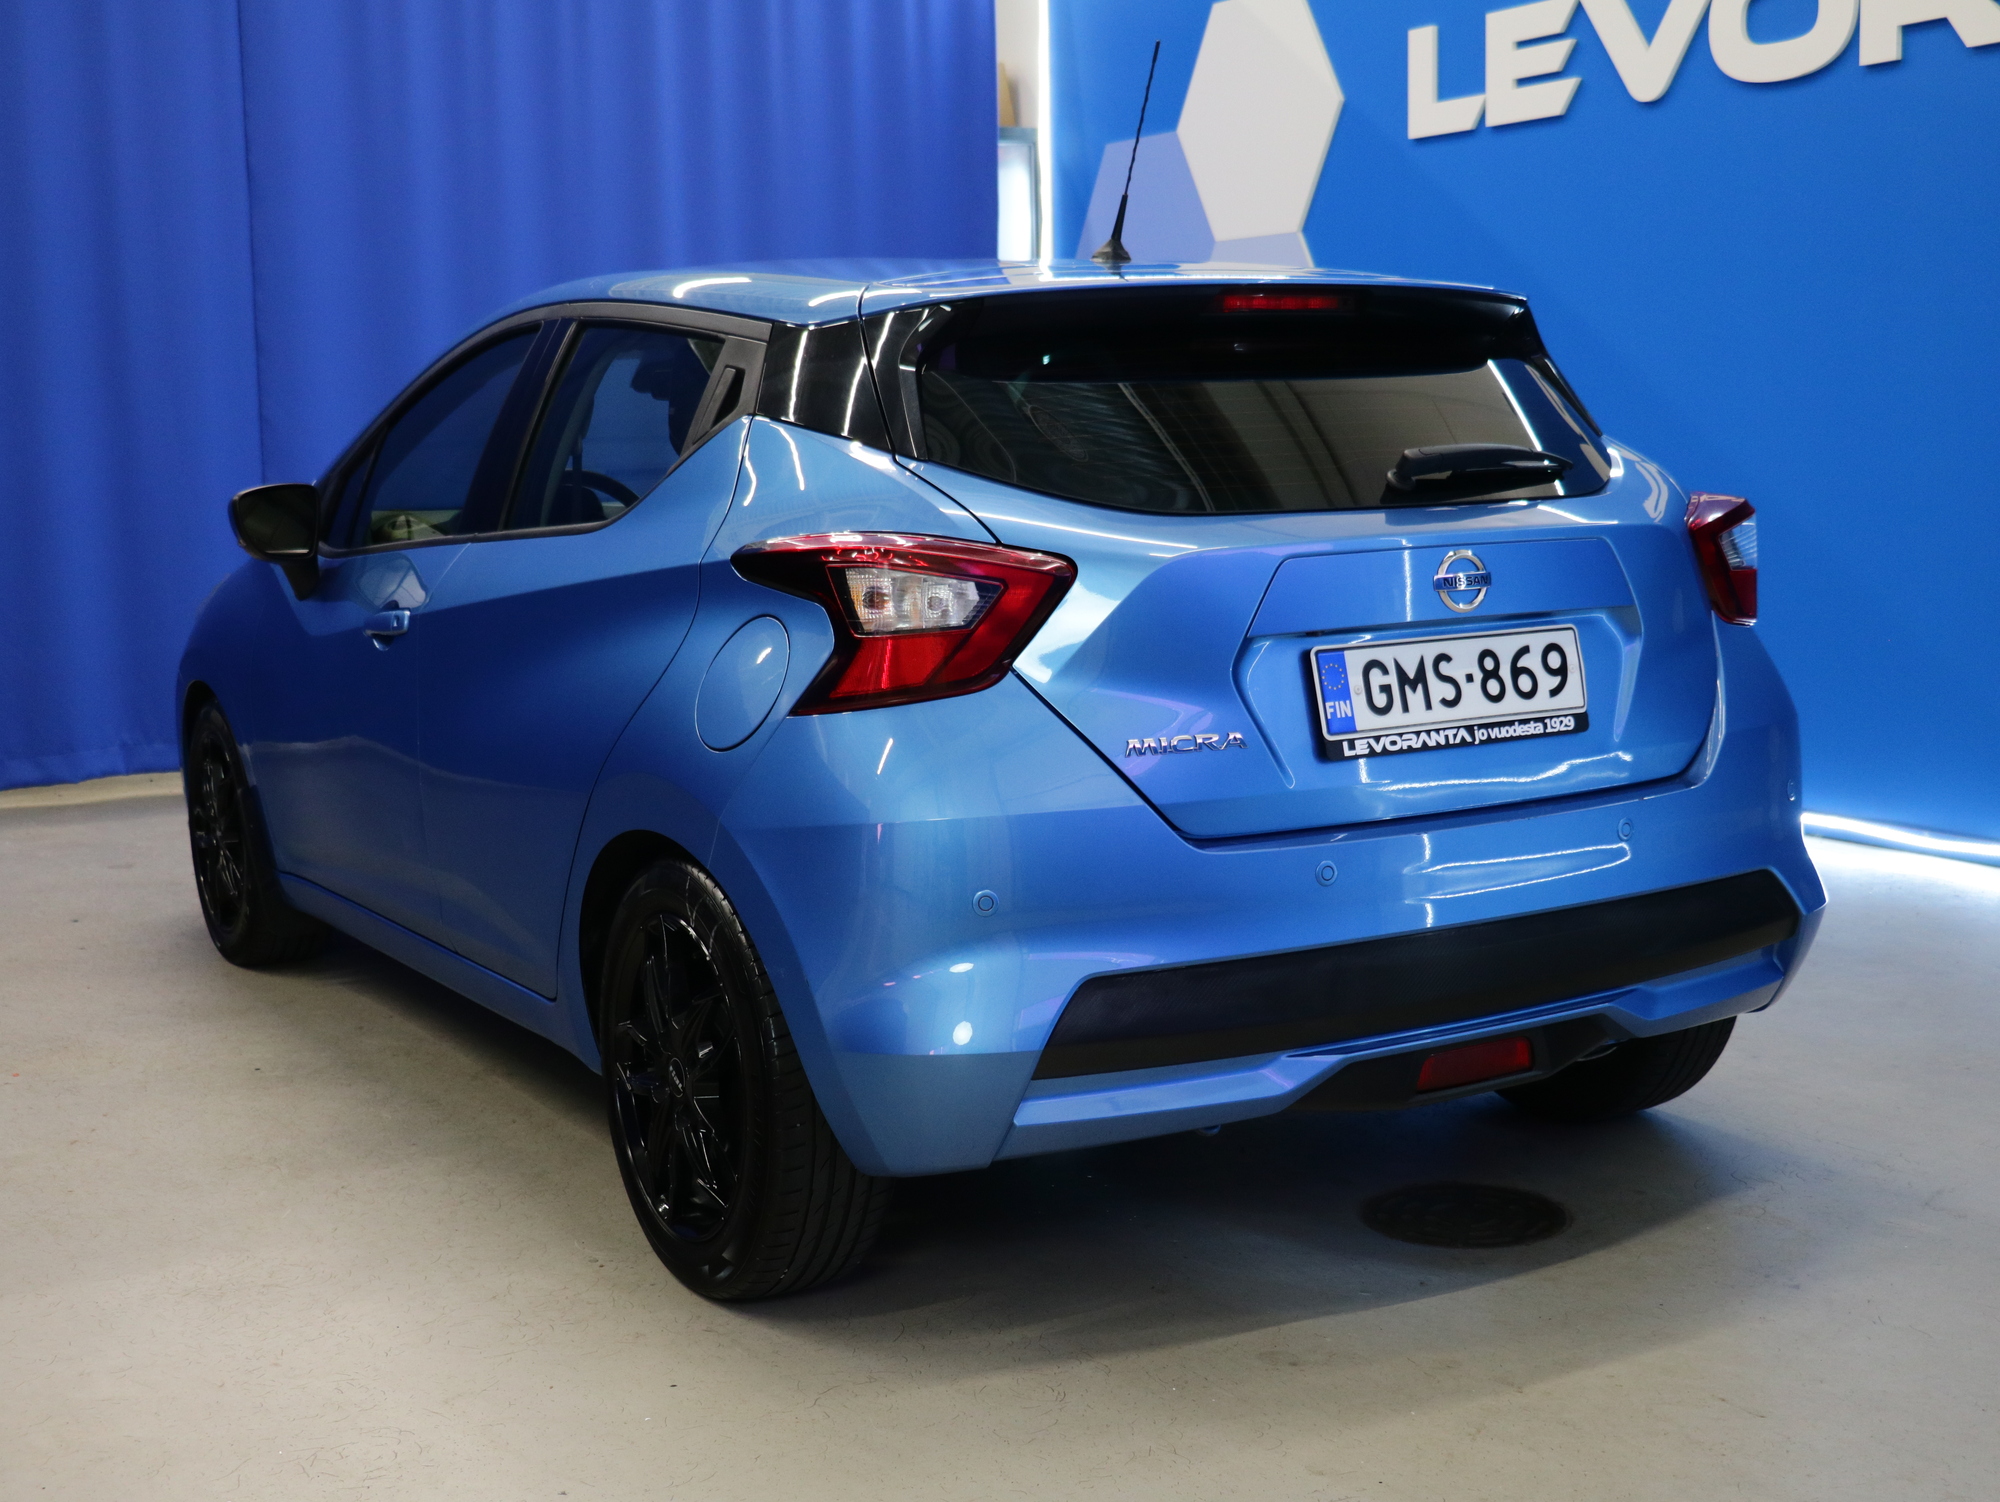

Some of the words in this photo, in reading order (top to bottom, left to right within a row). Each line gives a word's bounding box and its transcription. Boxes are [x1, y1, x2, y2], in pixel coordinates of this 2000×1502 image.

[1443, 575, 1489, 587] NISSAN
[1325, 699, 1353, 720] FIN
[1125, 731, 1249, 758] MICRA
[1342, 727, 1473, 757] LEVORANTA
[1474, 725, 1490, 745] jo
[1490, 719, 1544, 738] vuodesta
[1544, 715, 1575, 733] 1929
